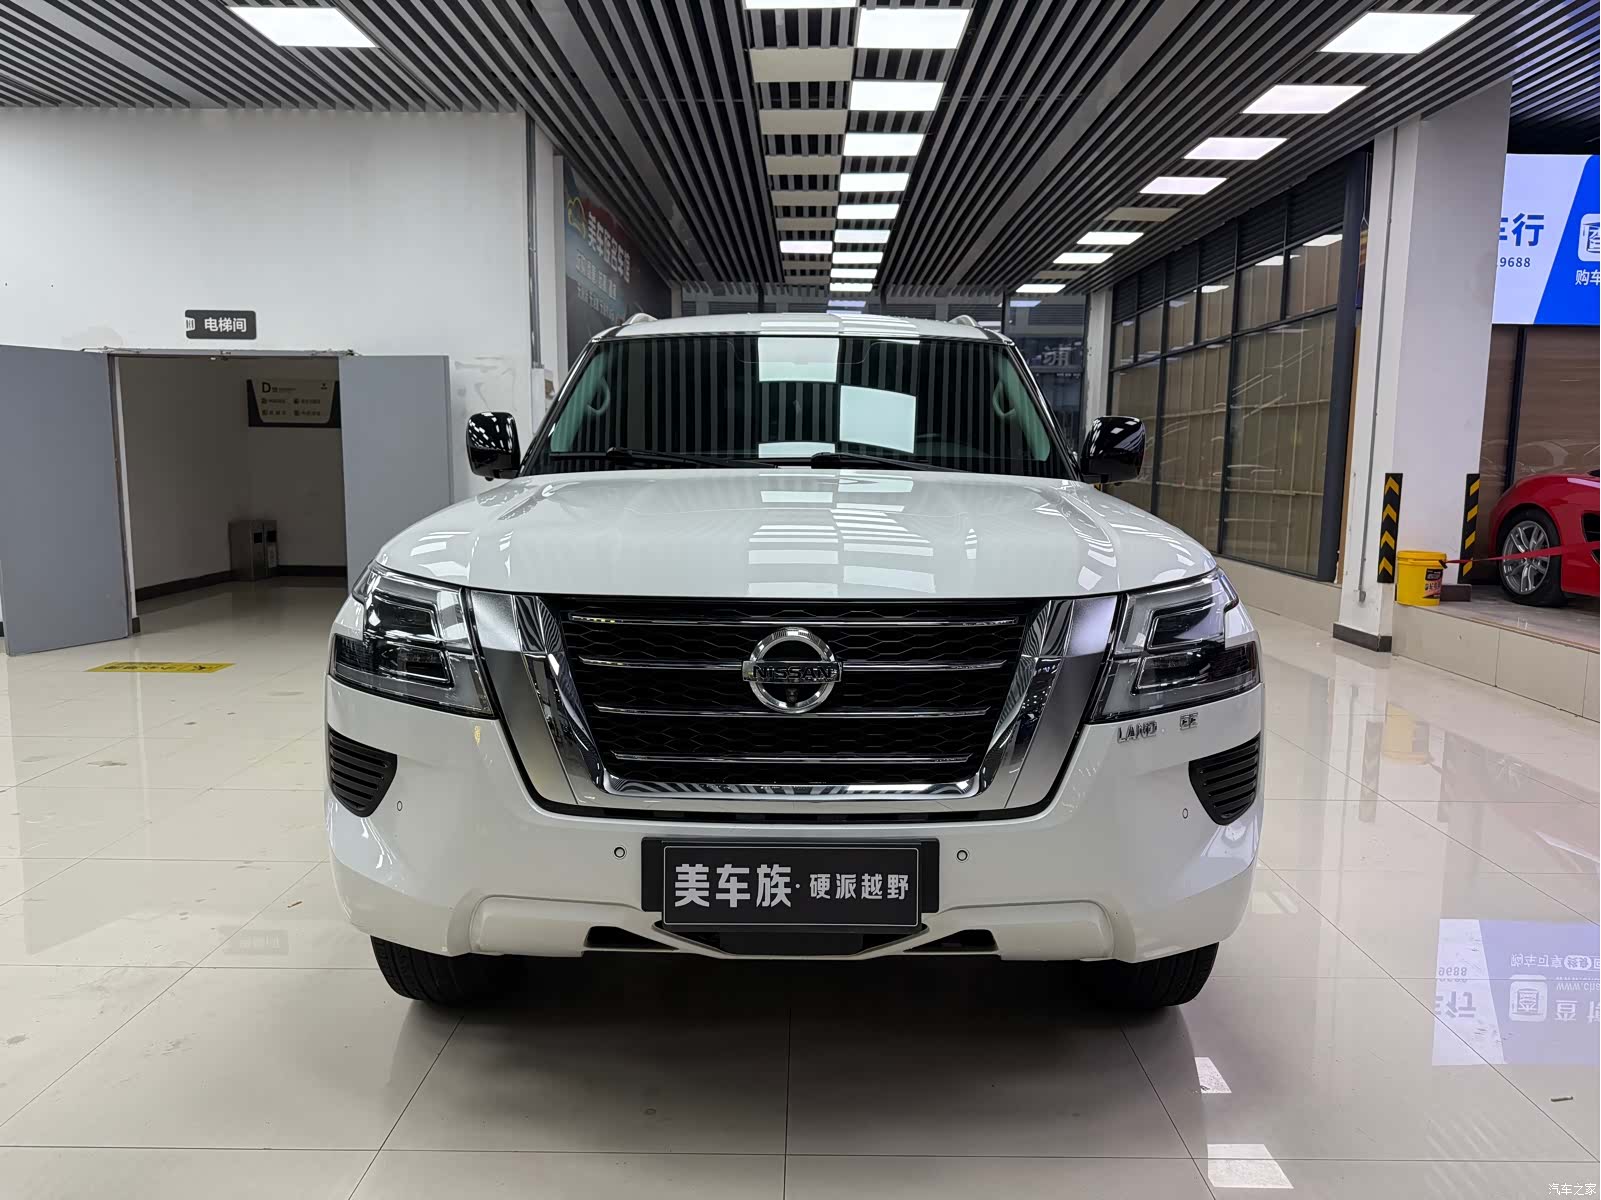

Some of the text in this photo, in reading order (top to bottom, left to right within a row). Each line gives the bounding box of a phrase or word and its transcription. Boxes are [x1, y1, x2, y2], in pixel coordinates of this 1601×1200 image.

[1497, 257, 1531, 268] 9688
[204, 317, 247, 332] 电梯间
[752, 663, 834, 681] NISSAN
[1117, 720, 1157, 744] LAND
